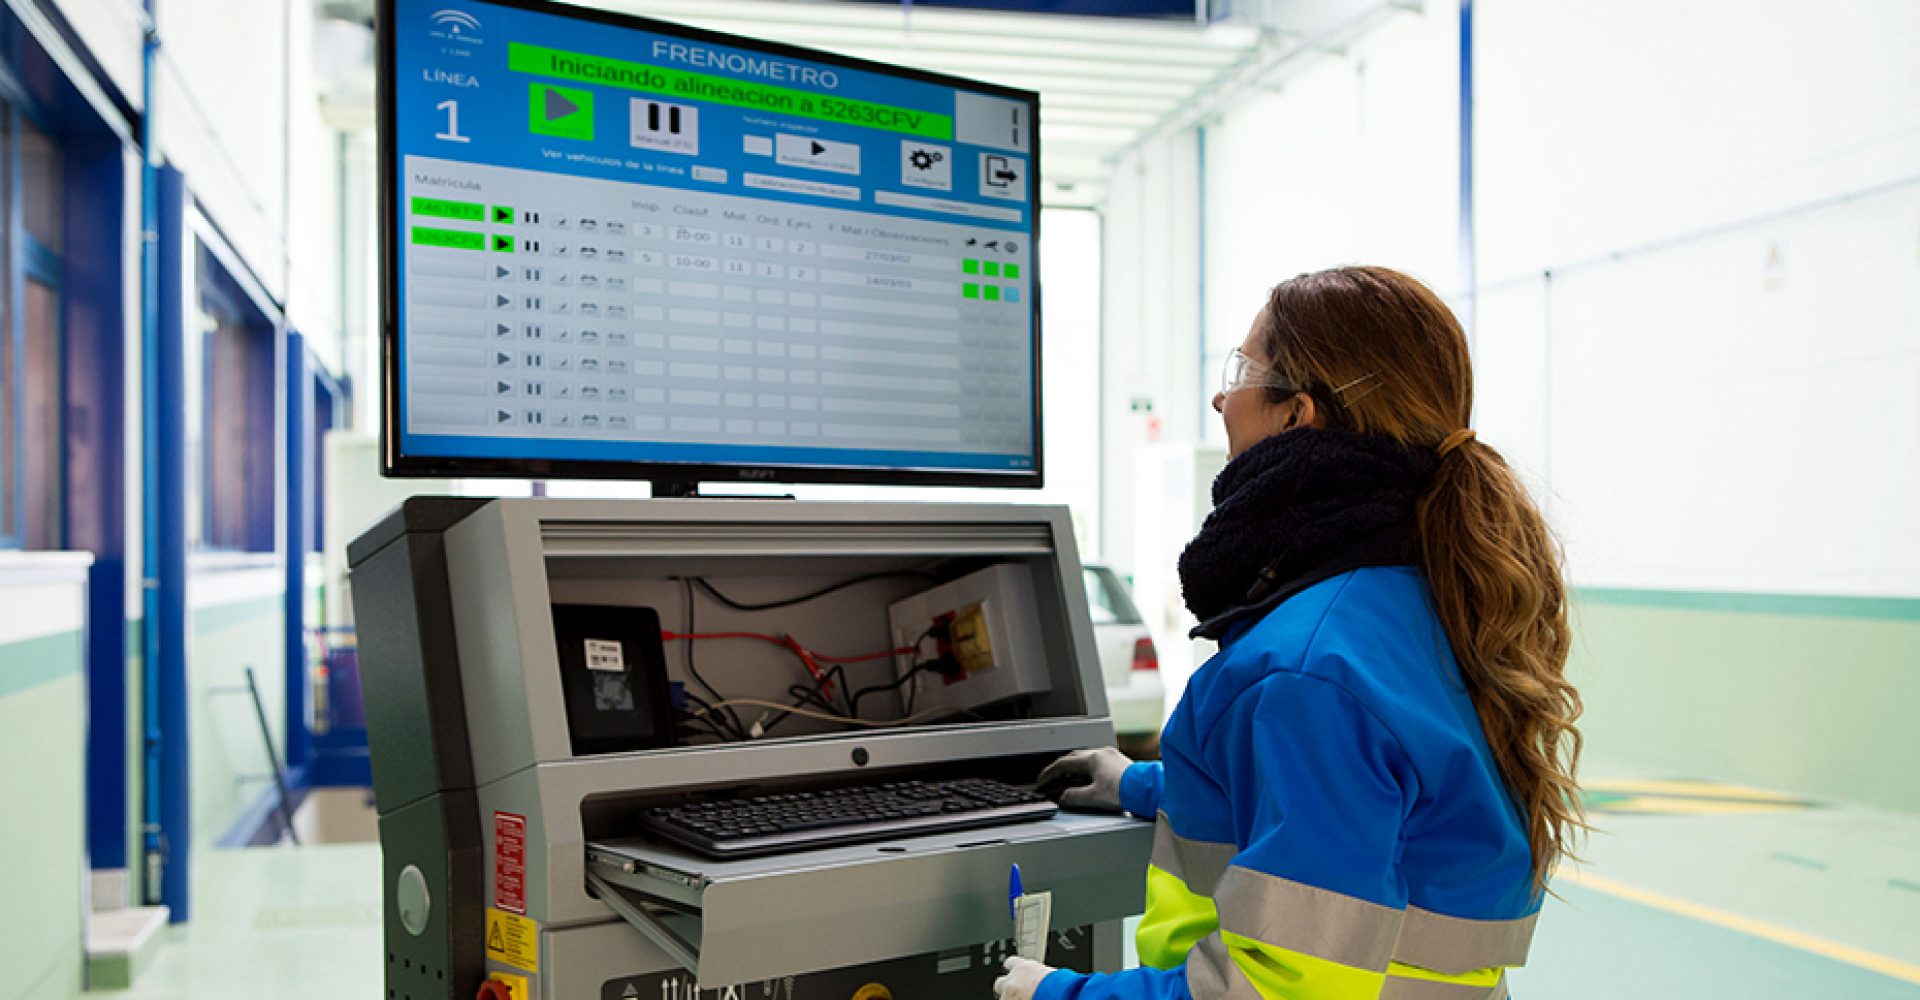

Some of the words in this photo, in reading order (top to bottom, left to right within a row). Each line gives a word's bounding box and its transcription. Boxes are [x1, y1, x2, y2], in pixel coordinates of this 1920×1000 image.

[652, 40, 838, 89] FRENOMETRO
[422, 68, 481, 89] LÍNEA
[550, 54, 666, 90] Iniciando
[674, 71, 793, 109] alineacion
[798, 100, 814, 114] a
[821, 98, 922, 130] 5263CFV
[435, 98, 472, 144] 1
[541, 147, 563, 159] Ver
[625, 159, 641, 170] de
[643, 160, 654, 172] la
[729, 235, 744, 247] 11
[729, 262, 744, 273] 11
